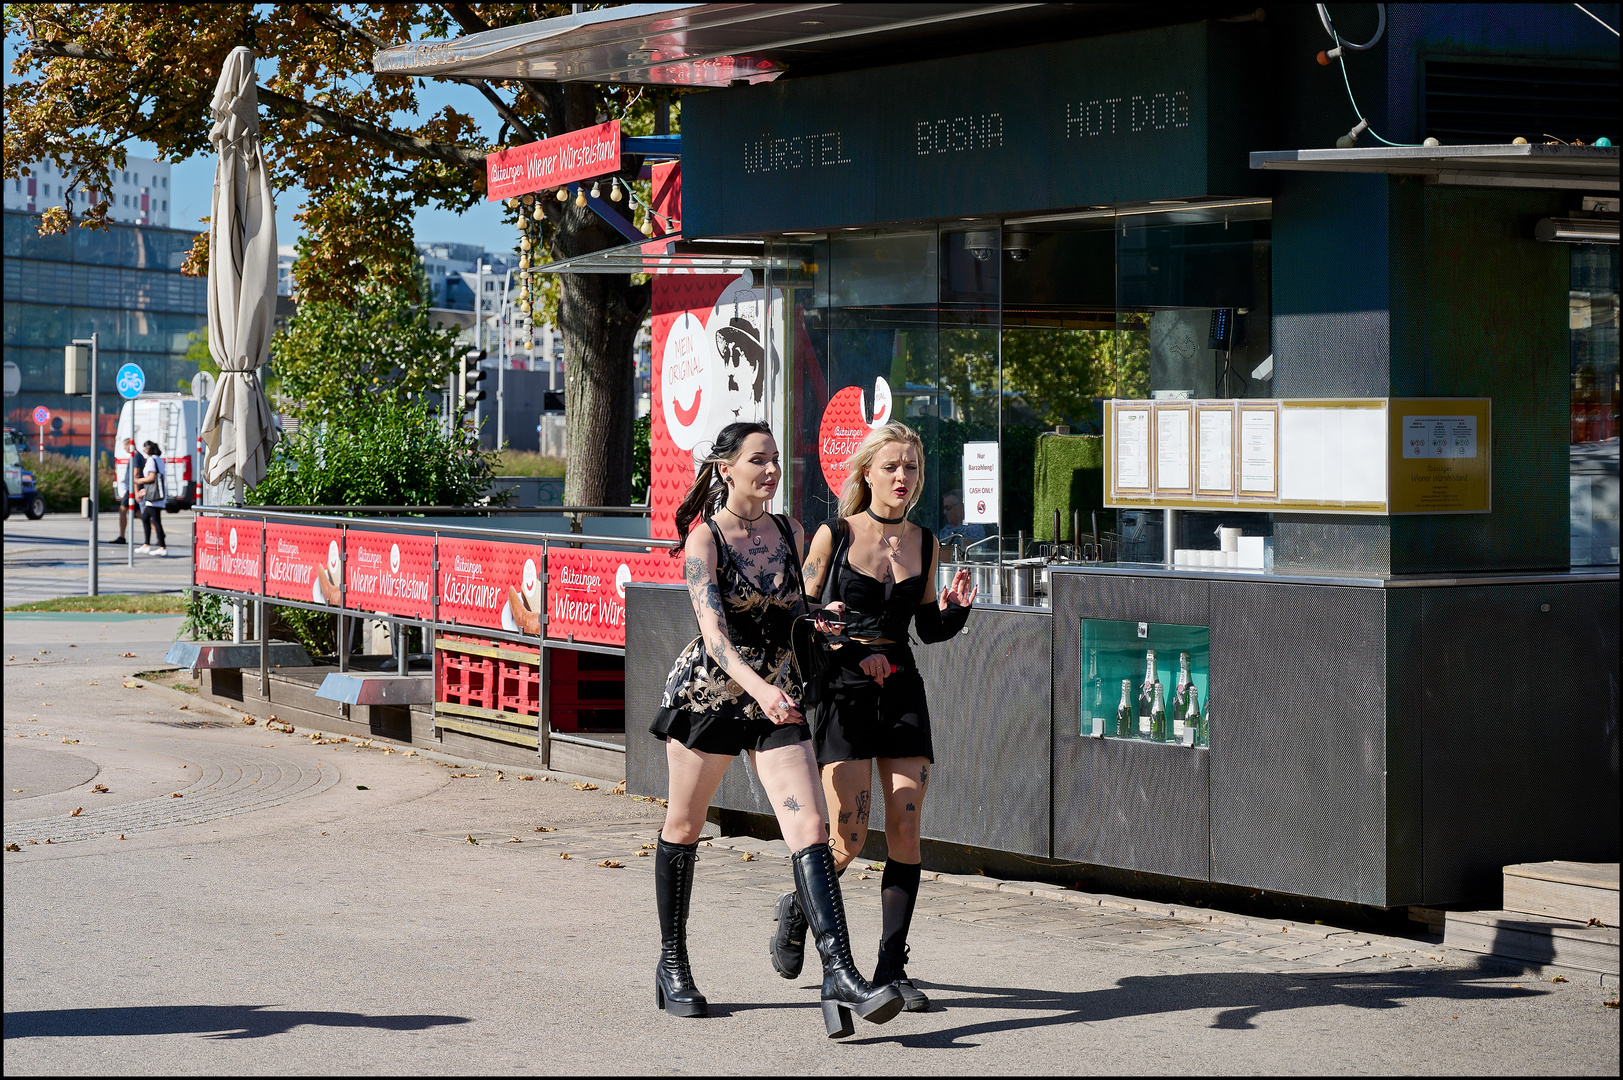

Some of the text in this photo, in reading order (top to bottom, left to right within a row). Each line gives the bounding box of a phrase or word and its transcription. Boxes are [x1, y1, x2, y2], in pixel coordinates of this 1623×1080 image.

[1066, 91, 1189, 138] HOT DOG
[917, 113, 1002, 155] BOSNA
[526, 153, 558, 179] Wiener
[560, 132, 616, 171] Würstelstand
[744, 133, 851, 173] WÜRSTEL
[674, 334, 694, 359] MEIN
[668, 355, 704, 385] ORIGINAL
[199, 548, 220, 571] Wiener
[269, 554, 313, 584] Käsekrainer
[350, 566, 429, 602] Wiener Würstelstand
[443, 573, 501, 609] Käsekrainer
[555, 593, 596, 622] Wiener
